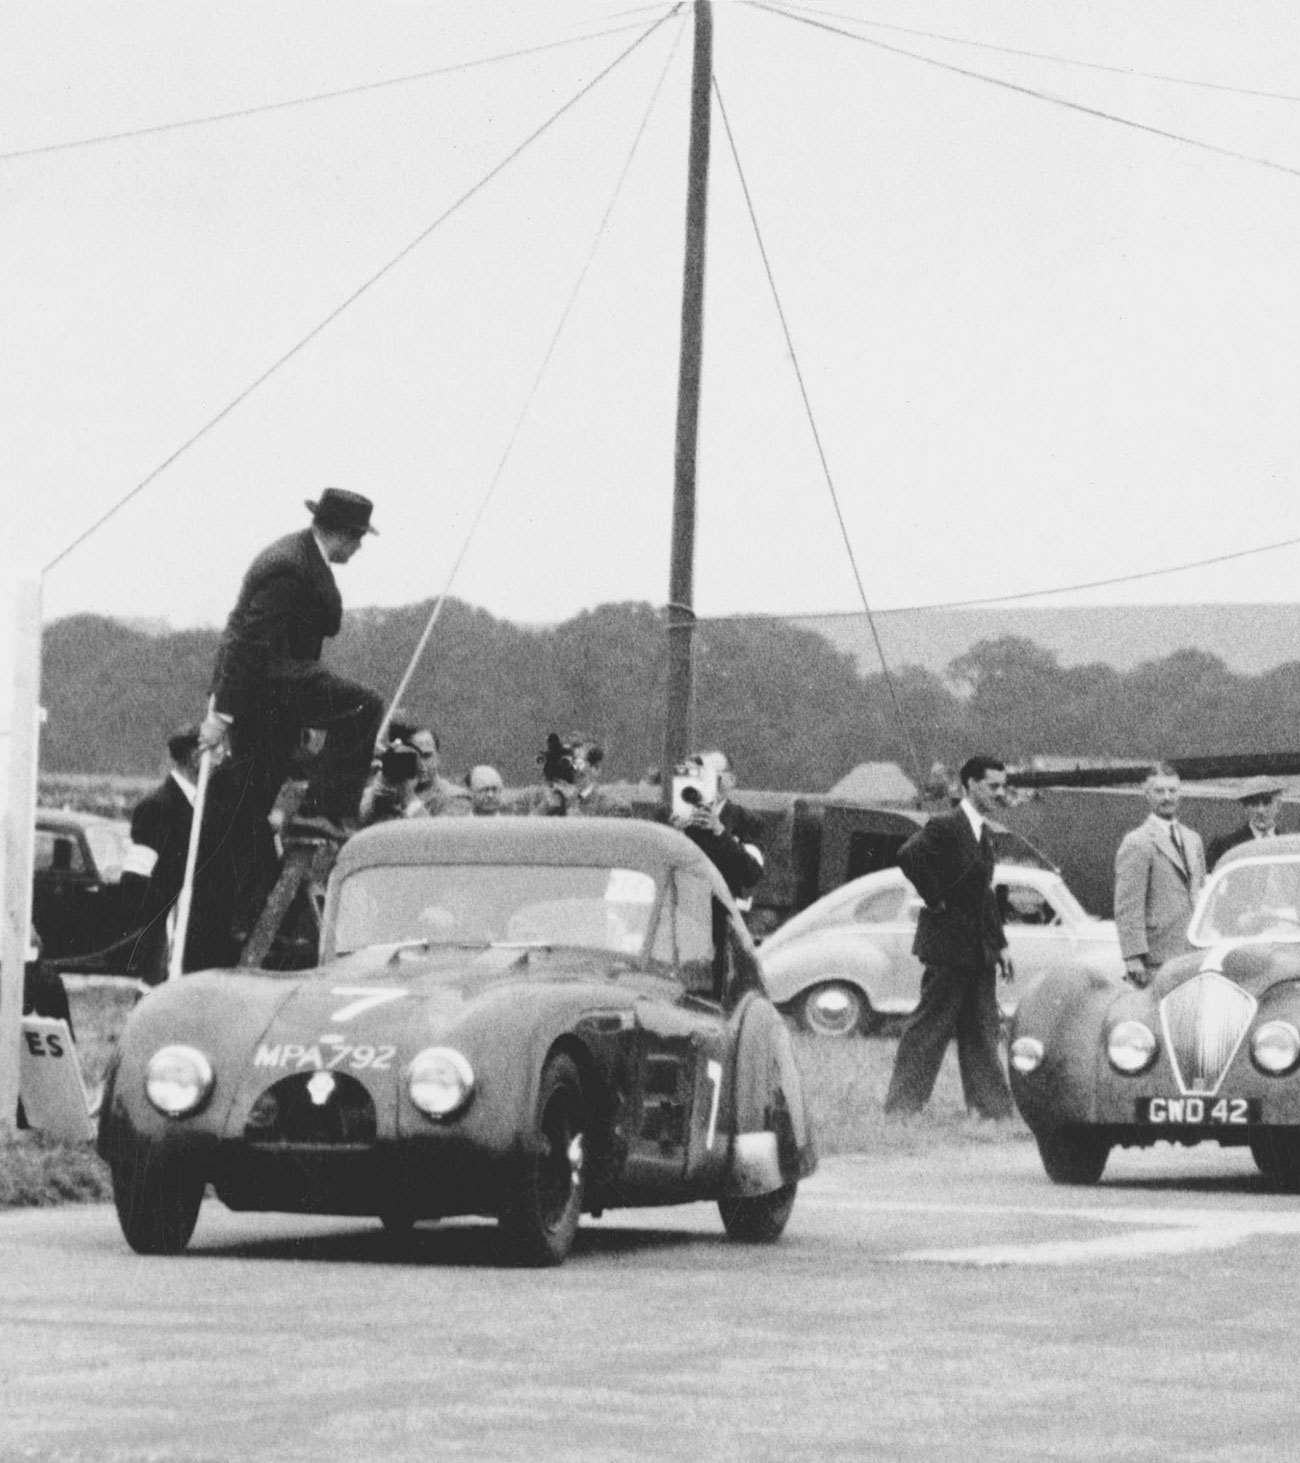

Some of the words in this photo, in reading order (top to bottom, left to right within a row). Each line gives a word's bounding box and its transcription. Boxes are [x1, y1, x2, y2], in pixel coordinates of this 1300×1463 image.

[330, 986, 409, 1022] 7
[1150, 1097, 1204, 1123] GWD
[1211, 1098, 1248, 1124] 42
